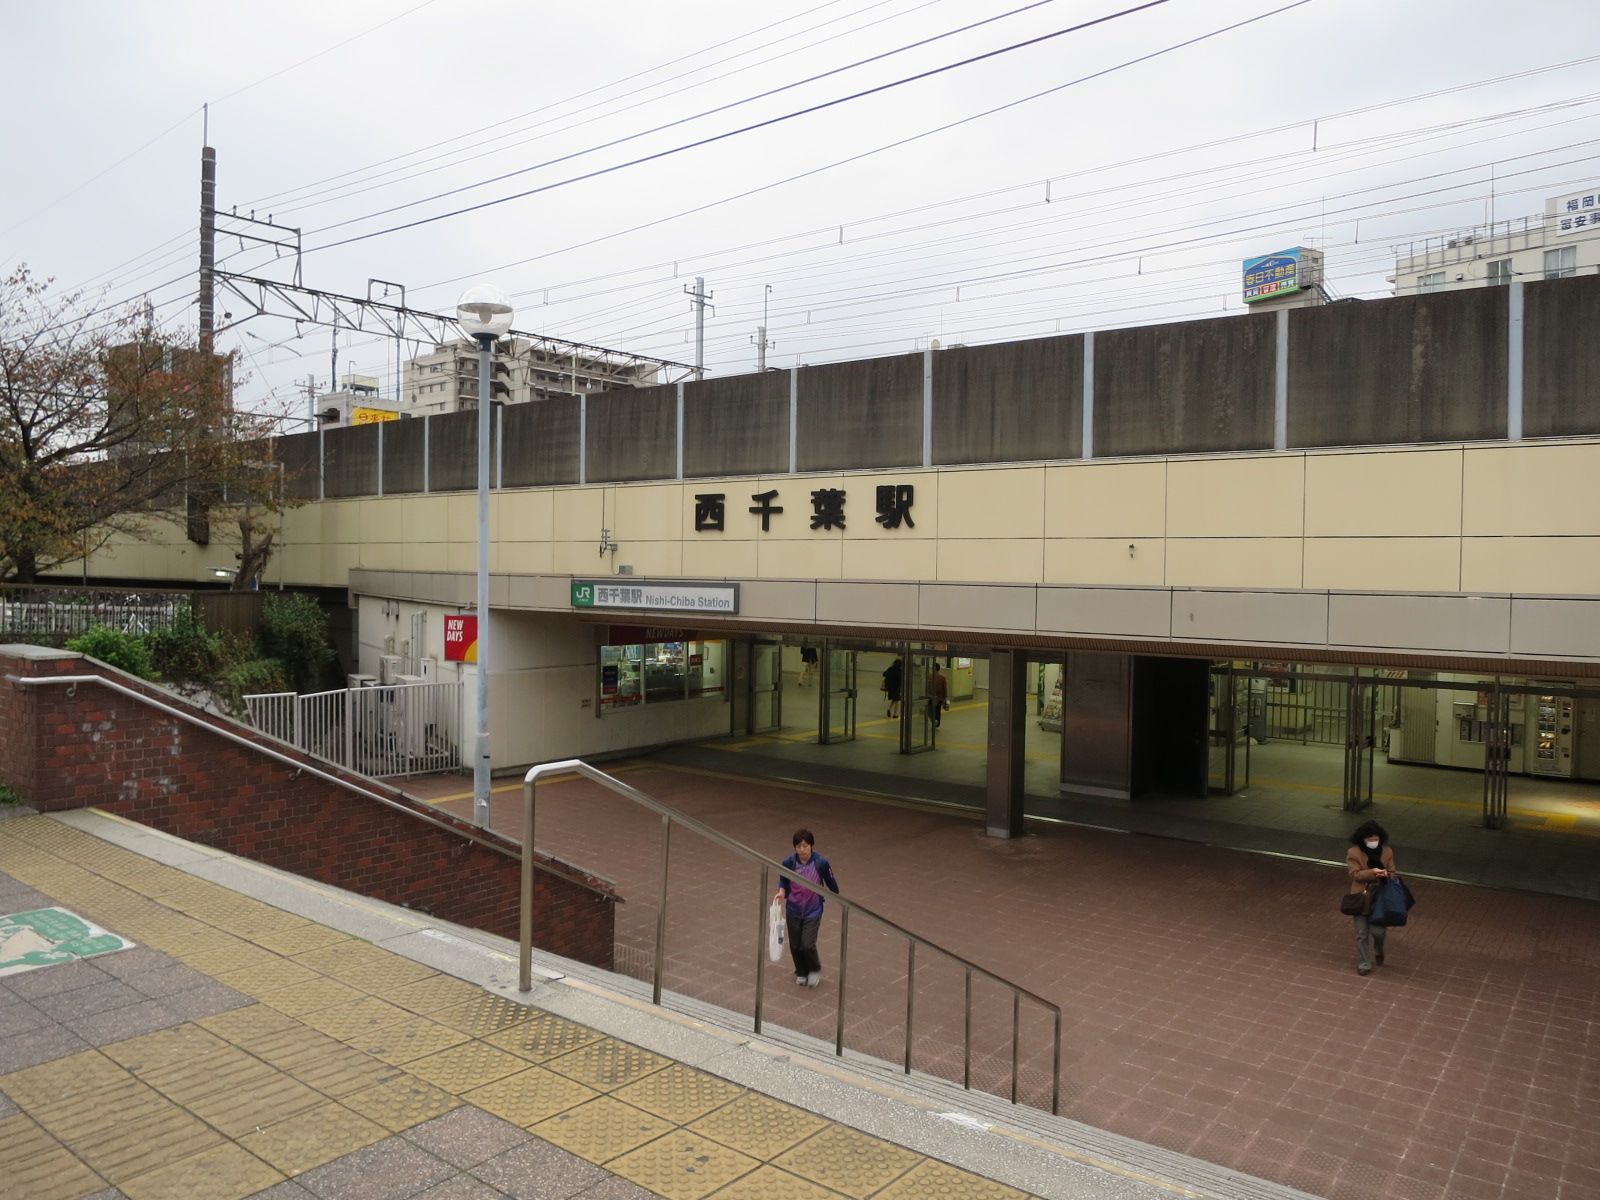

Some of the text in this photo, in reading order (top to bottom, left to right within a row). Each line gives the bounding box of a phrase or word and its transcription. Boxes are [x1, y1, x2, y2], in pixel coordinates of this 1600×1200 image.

[694, 484, 915, 532] 西千葉駅
[576, 587, 591, 599] JR
[598, 588, 730, 608] 西千葉駅 Nishi-Chiba Station
[447, 619, 464, 630] NEW
[446, 631, 464, 642] DAYS
